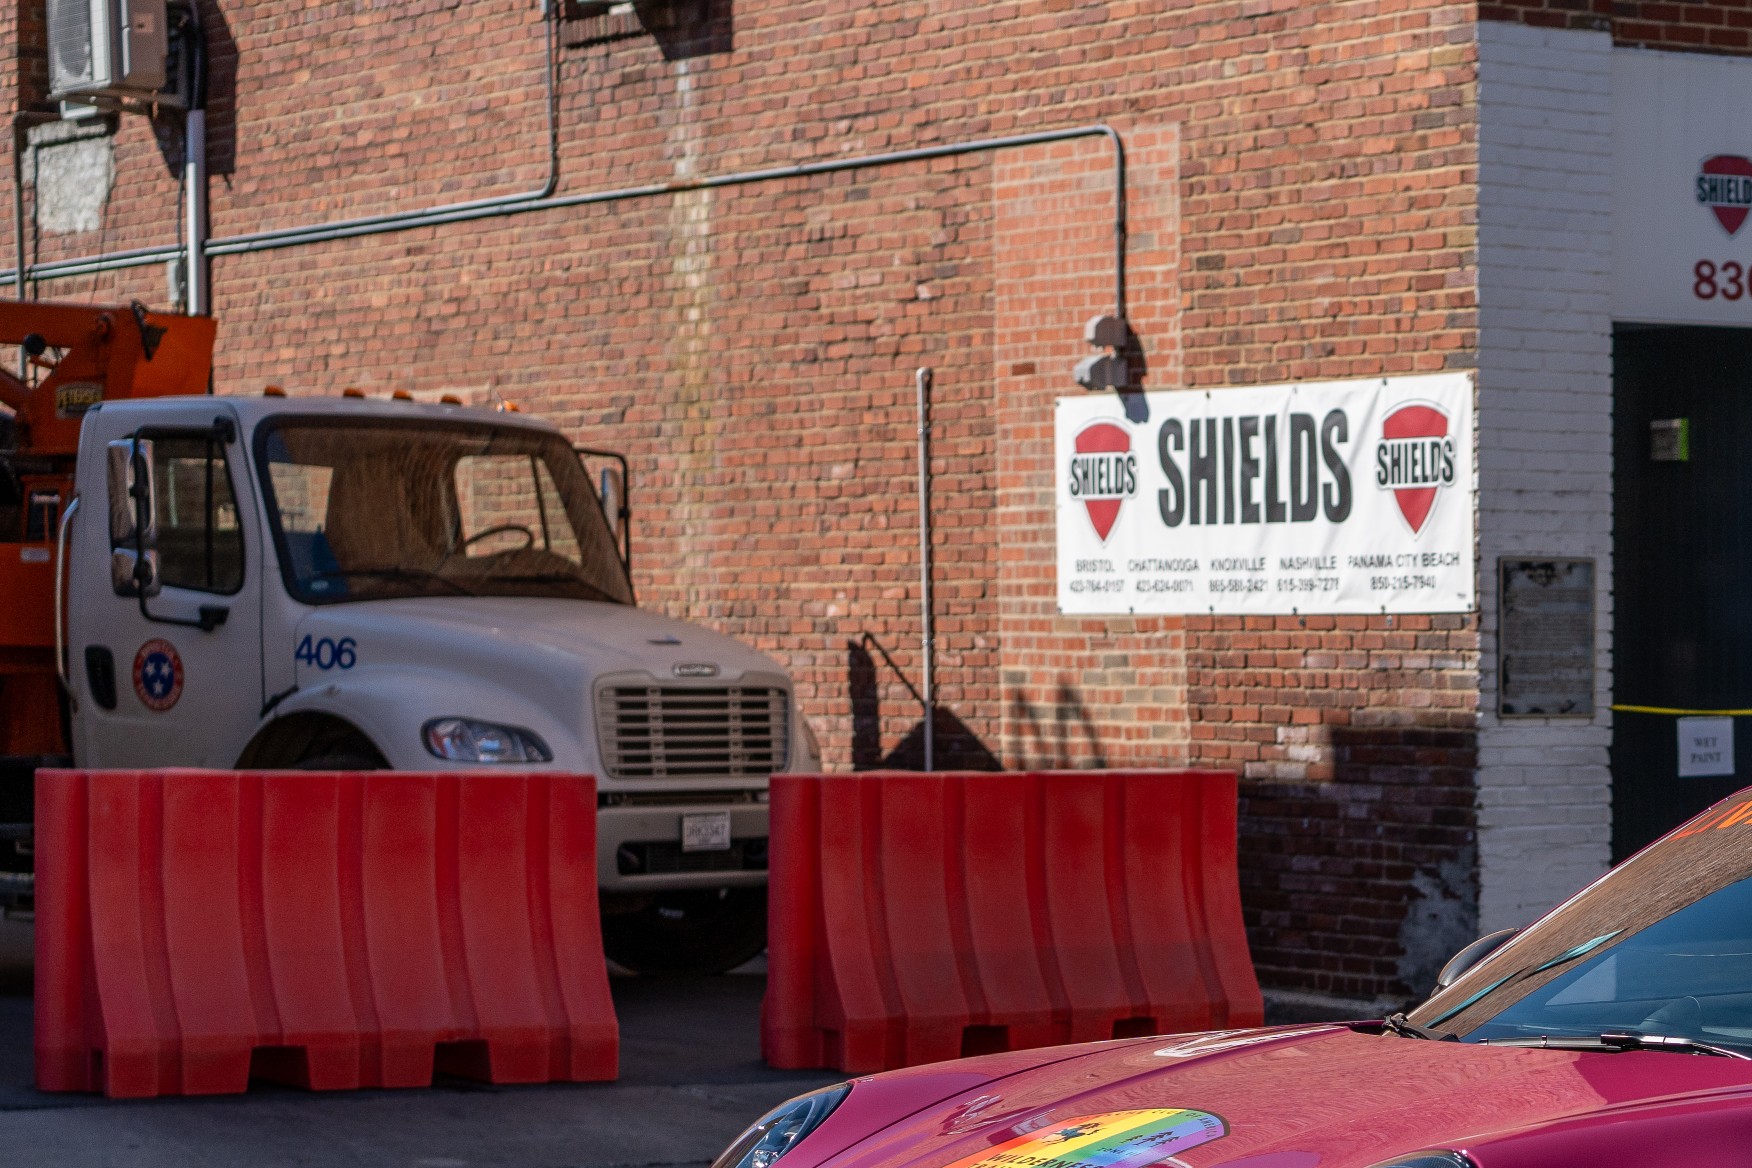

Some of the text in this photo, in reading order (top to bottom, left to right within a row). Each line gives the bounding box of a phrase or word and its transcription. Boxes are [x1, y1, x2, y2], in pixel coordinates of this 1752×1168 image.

[1157, 408, 1353, 528] SHIELDS
[1376, 440, 1455, 486] SHIELDS
[1070, 454, 1138, 497] SHIELDS
[1127, 558, 1200, 573] CHATTANOOGA
[1209, 557, 1267, 572] KNOXVILLE
[1279, 555, 1337, 571] NASHVILLE
[1348, 553, 1393, 569] PANAMA
[1421, 551, 1461, 568] BEACH
[294, 634, 357, 670] 406
[1693, 736, 1718, 747] WET
[1691, 752, 1722, 763] PAINT
